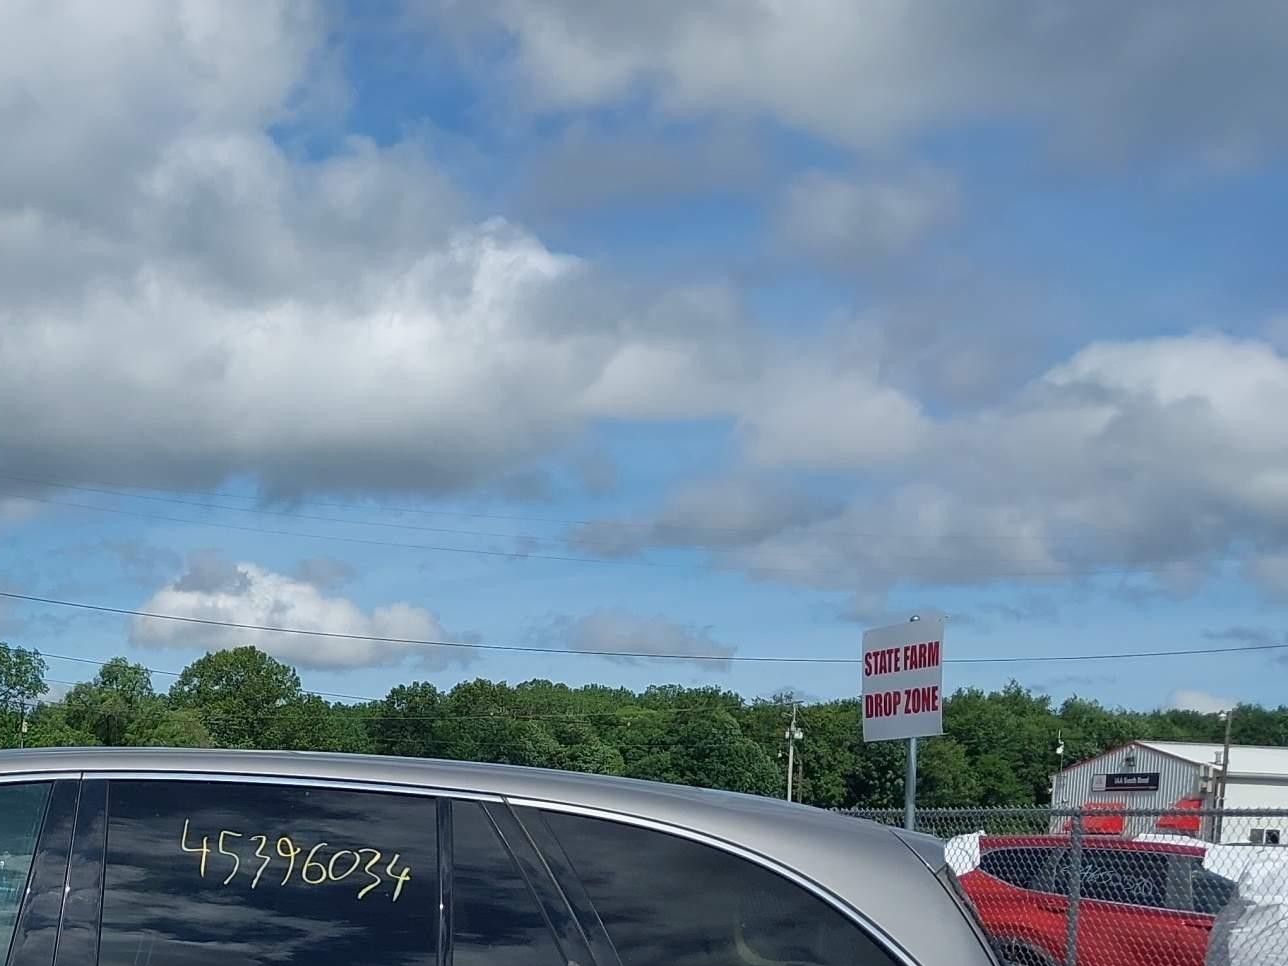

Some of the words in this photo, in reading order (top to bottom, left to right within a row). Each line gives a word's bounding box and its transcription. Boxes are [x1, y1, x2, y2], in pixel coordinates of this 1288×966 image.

[864, 647, 901, 677] STATE
[903, 641, 940, 671] FARM
[865, 690, 901, 719] DROP
[904, 685, 939, 715] ZONE
[181, 817, 411, 902] 45396034
